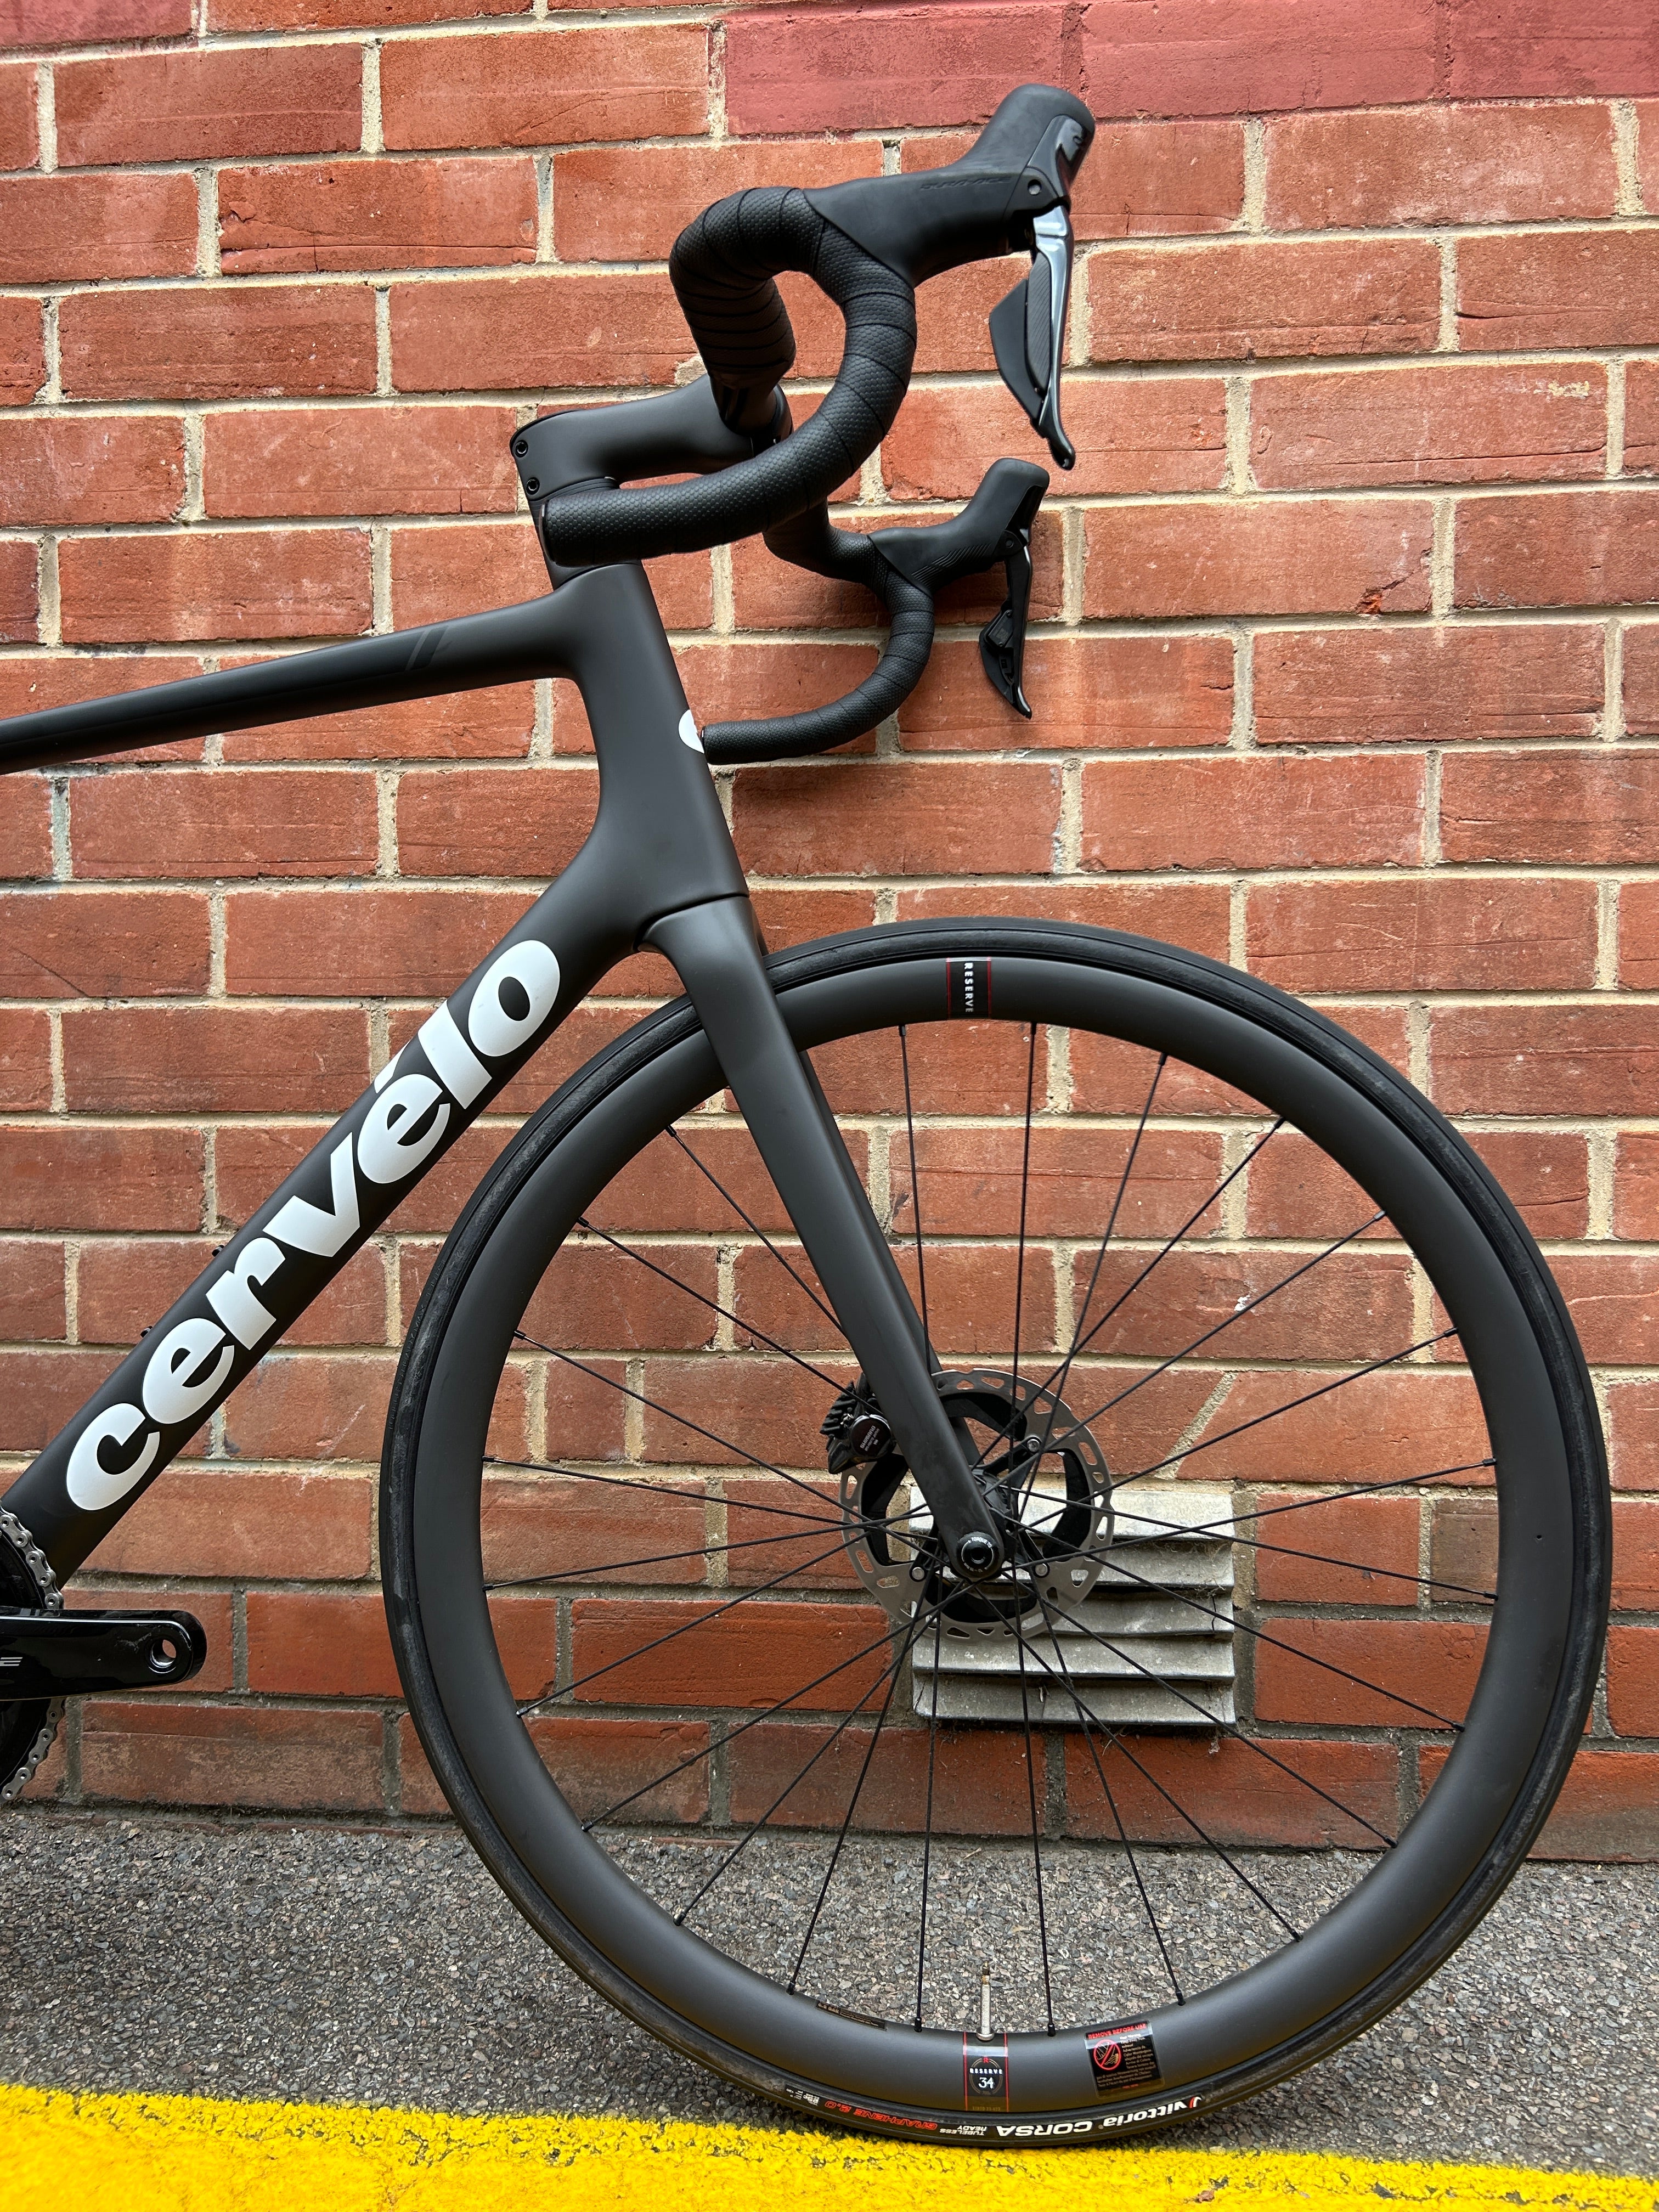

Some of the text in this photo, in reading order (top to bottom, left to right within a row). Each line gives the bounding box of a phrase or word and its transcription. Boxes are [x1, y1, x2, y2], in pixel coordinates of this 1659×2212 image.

[964, 962, 974, 1013] RESERVE
[413, 1304, 426, 1332] MAX
[1088, 2030, 1112, 2039] REMOVE
[1112, 2025, 1135, 2035] BEFORE
[978, 2077, 994, 2089] 34
[825, 2100, 938, 2130] GRAPHENE 2.0
[996, 2121, 1093, 2136] CORSA
